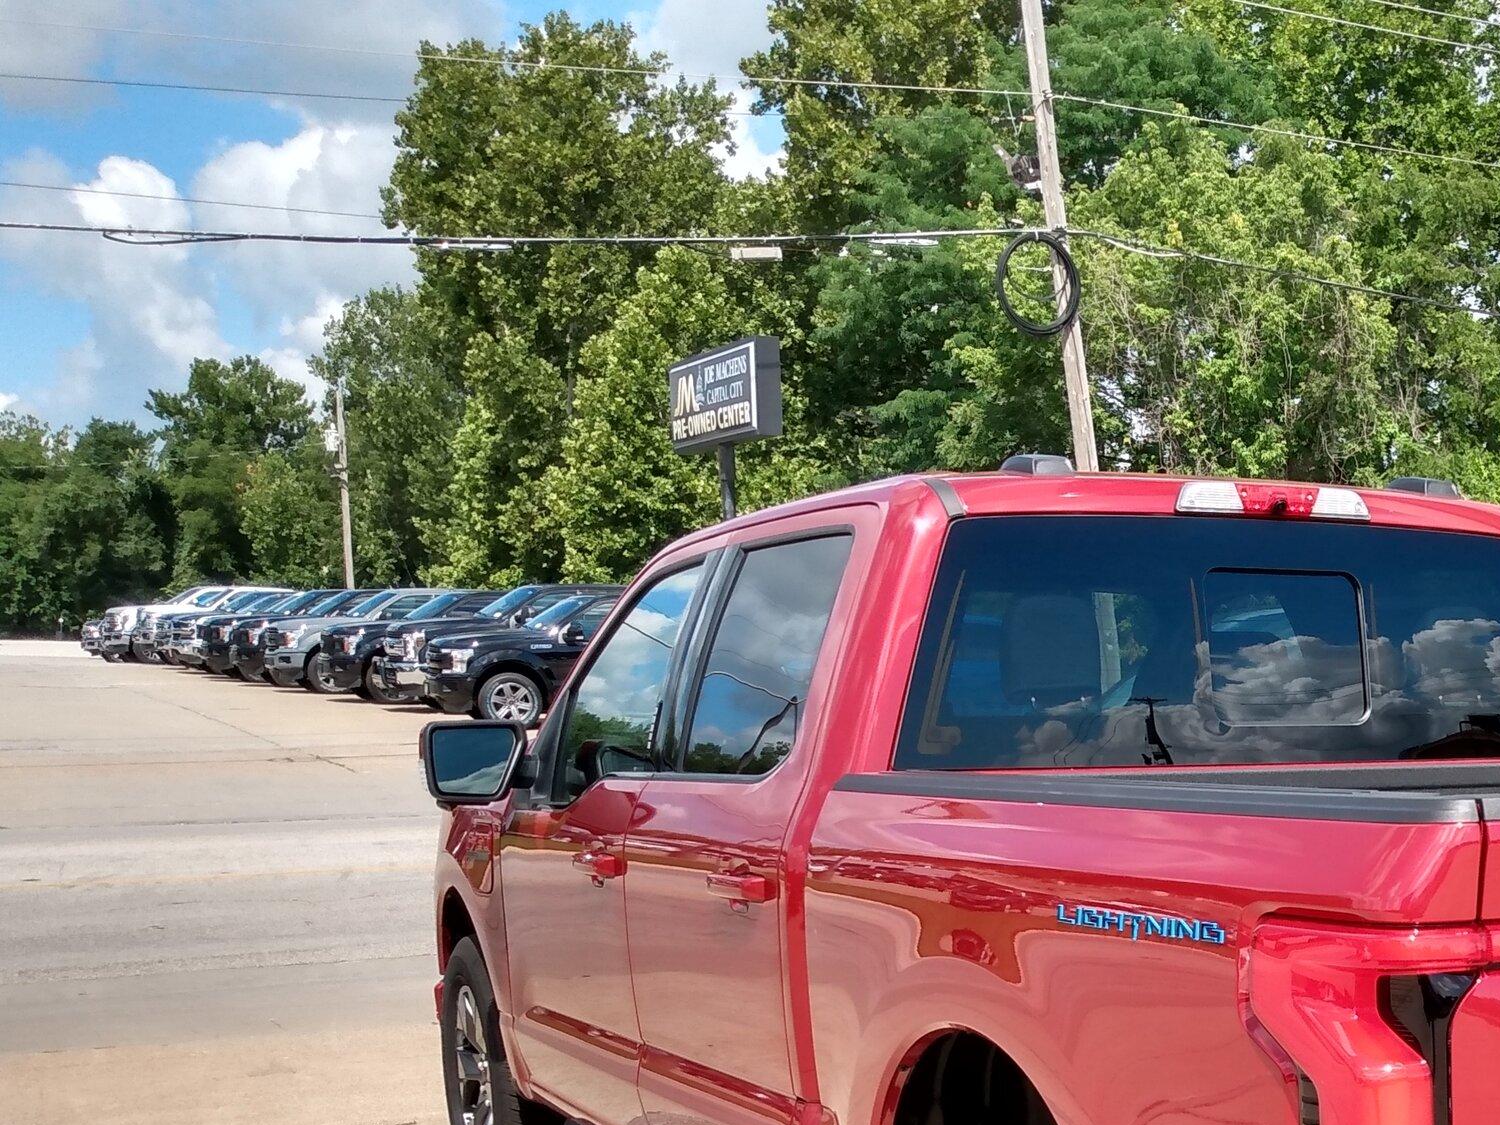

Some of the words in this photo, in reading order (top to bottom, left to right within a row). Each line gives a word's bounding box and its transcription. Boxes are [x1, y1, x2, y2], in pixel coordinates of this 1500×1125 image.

[704, 364, 715, 390] JOE
[716, 354, 747, 381] MACHENS
[706, 385, 729, 405] CAPITAL
[729, 380, 744, 399] CITY
[672, 409, 717, 441] PRE-OWNED
[717, 400, 751, 429] CENTER
[1056, 903, 1225, 944] LIGHTNING
